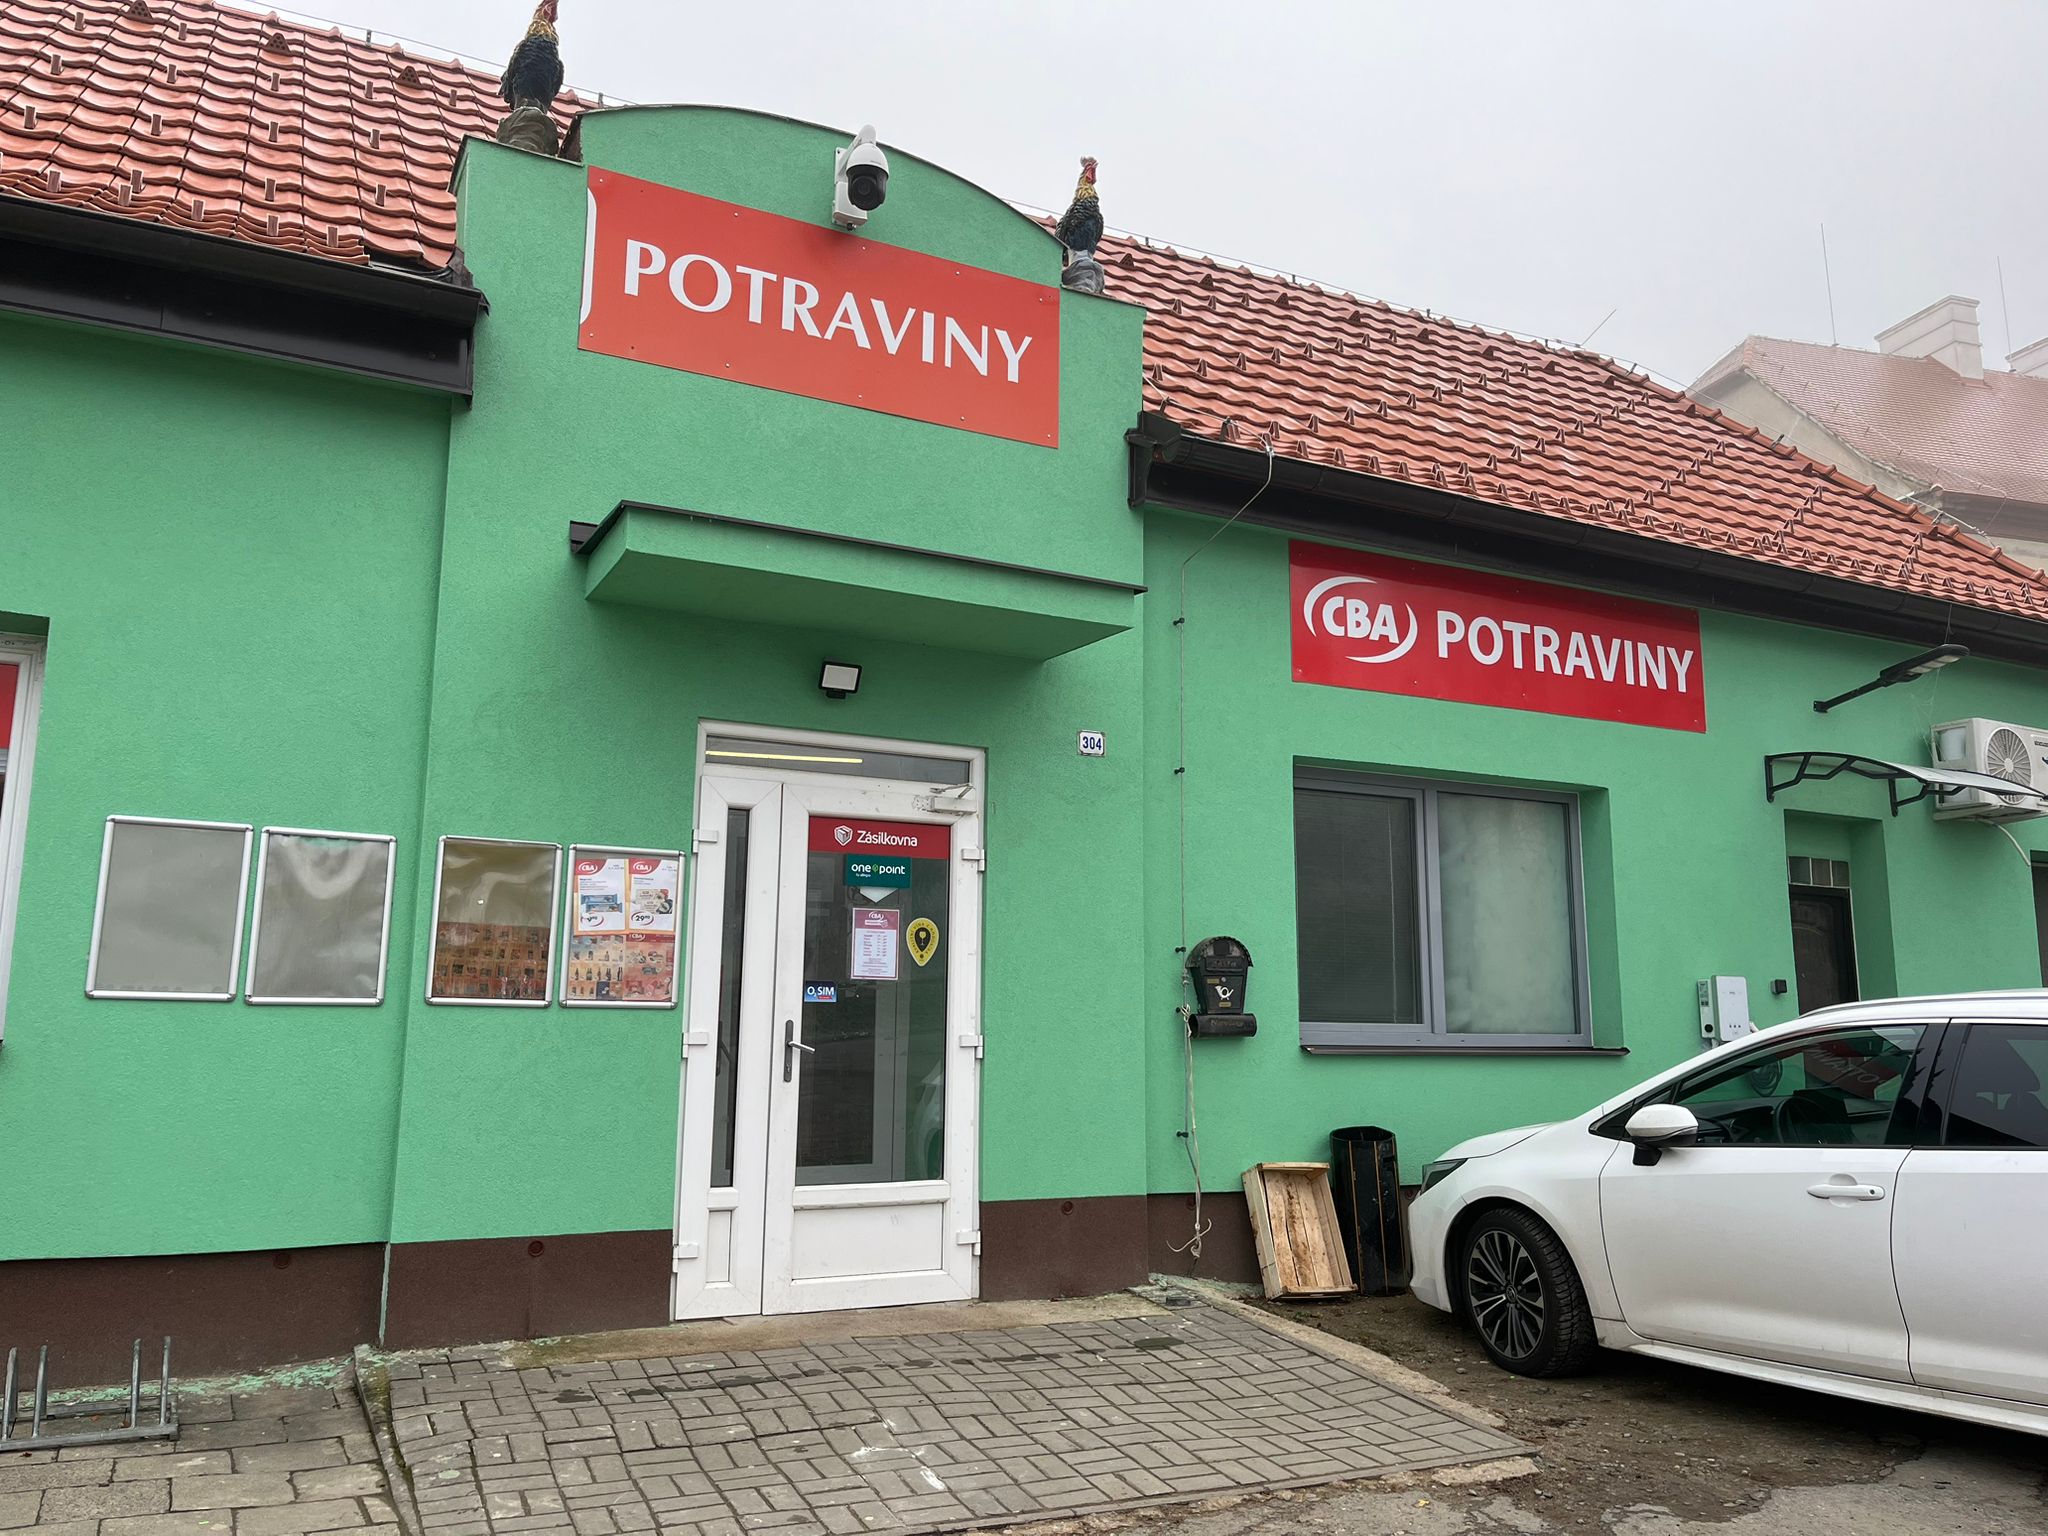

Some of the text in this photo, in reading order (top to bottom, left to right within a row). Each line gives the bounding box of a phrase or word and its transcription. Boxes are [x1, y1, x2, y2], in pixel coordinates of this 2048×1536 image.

[623, 238, 1033, 384] POTRAVINY
[1322, 596, 1694, 693] CBA POTRAVINY
[1082, 736, 1102, 751] 304
[857, 830, 918, 847] Zásilkovna
[851, 863, 906, 875] one point
[817, 986, 835, 996] SIM
